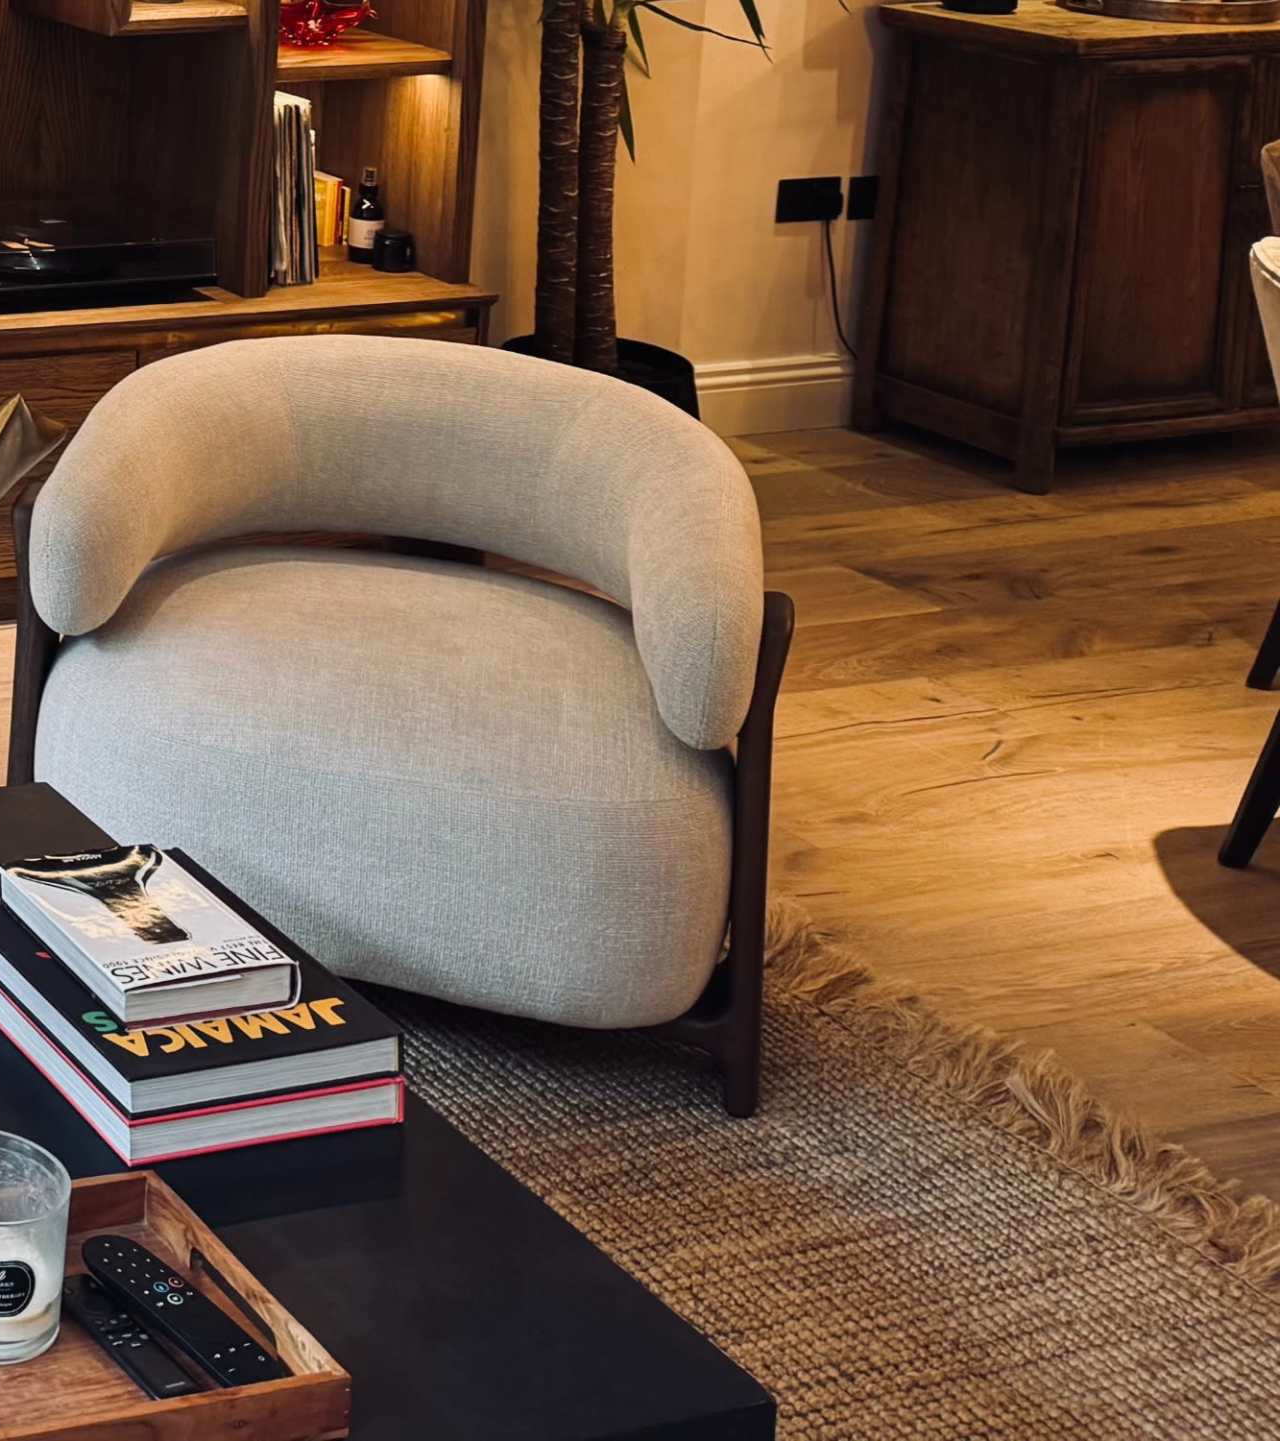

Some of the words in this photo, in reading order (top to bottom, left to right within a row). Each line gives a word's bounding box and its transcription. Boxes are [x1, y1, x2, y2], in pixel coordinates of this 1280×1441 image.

[213, 944, 285, 968] FINE
[110, 957, 208, 985] WINES
[102, 997, 346, 1057] JAMAICA
